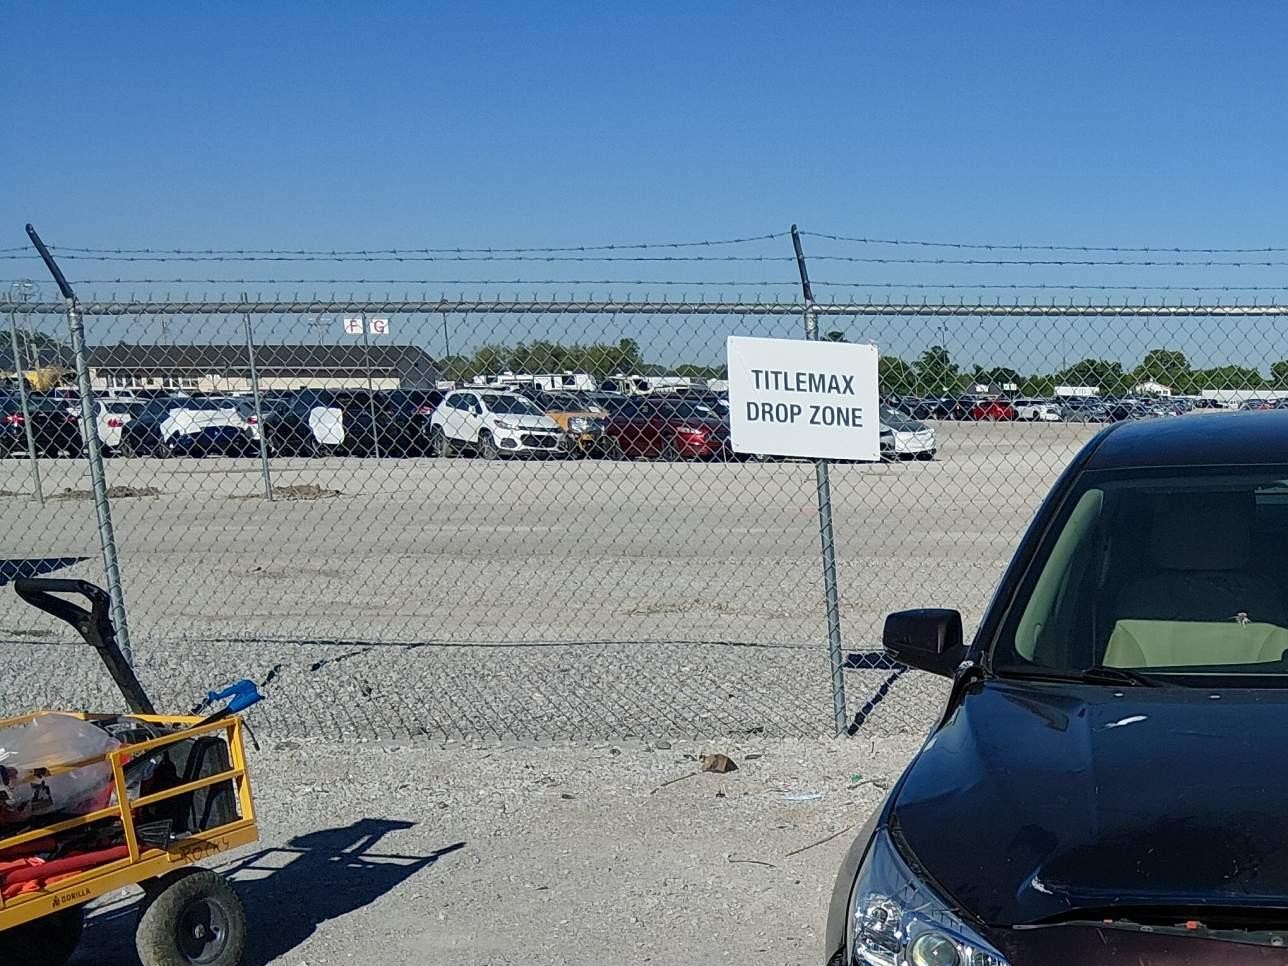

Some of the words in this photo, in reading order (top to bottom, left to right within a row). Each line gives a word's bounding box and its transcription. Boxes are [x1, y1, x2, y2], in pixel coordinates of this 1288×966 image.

[350, 320, 358, 332] F
[373, 320, 385, 333] G
[751, 369, 855, 395] TITLEMAX
[746, 401, 802, 423] DROP
[809, 405, 863, 428] ZONE
[61, 888, 91, 903] GORILLA
